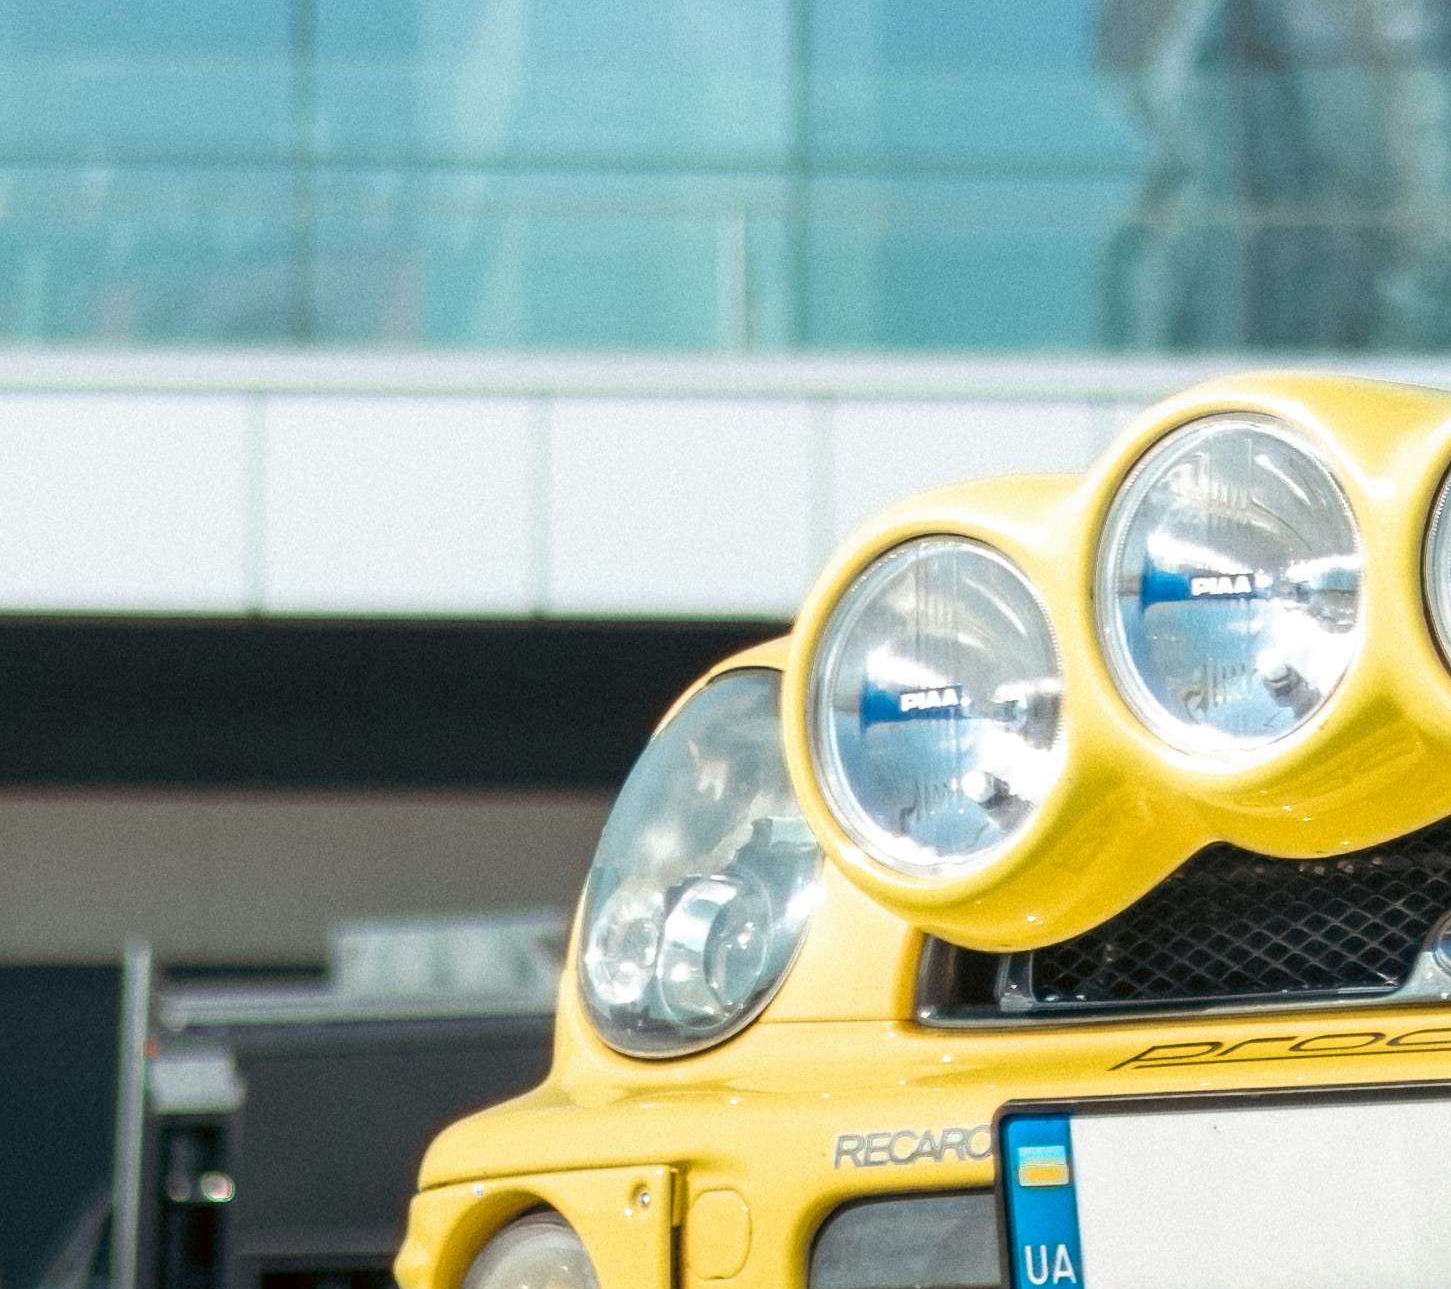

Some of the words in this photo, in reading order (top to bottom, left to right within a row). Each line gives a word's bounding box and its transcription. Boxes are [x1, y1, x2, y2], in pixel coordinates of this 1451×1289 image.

[1190, 575, 1252, 596] PIAA
[900, 687, 958, 711] PIAA
[834, 1124, 993, 1169] RECARO
[1024, 1244, 1077, 1286] UA
